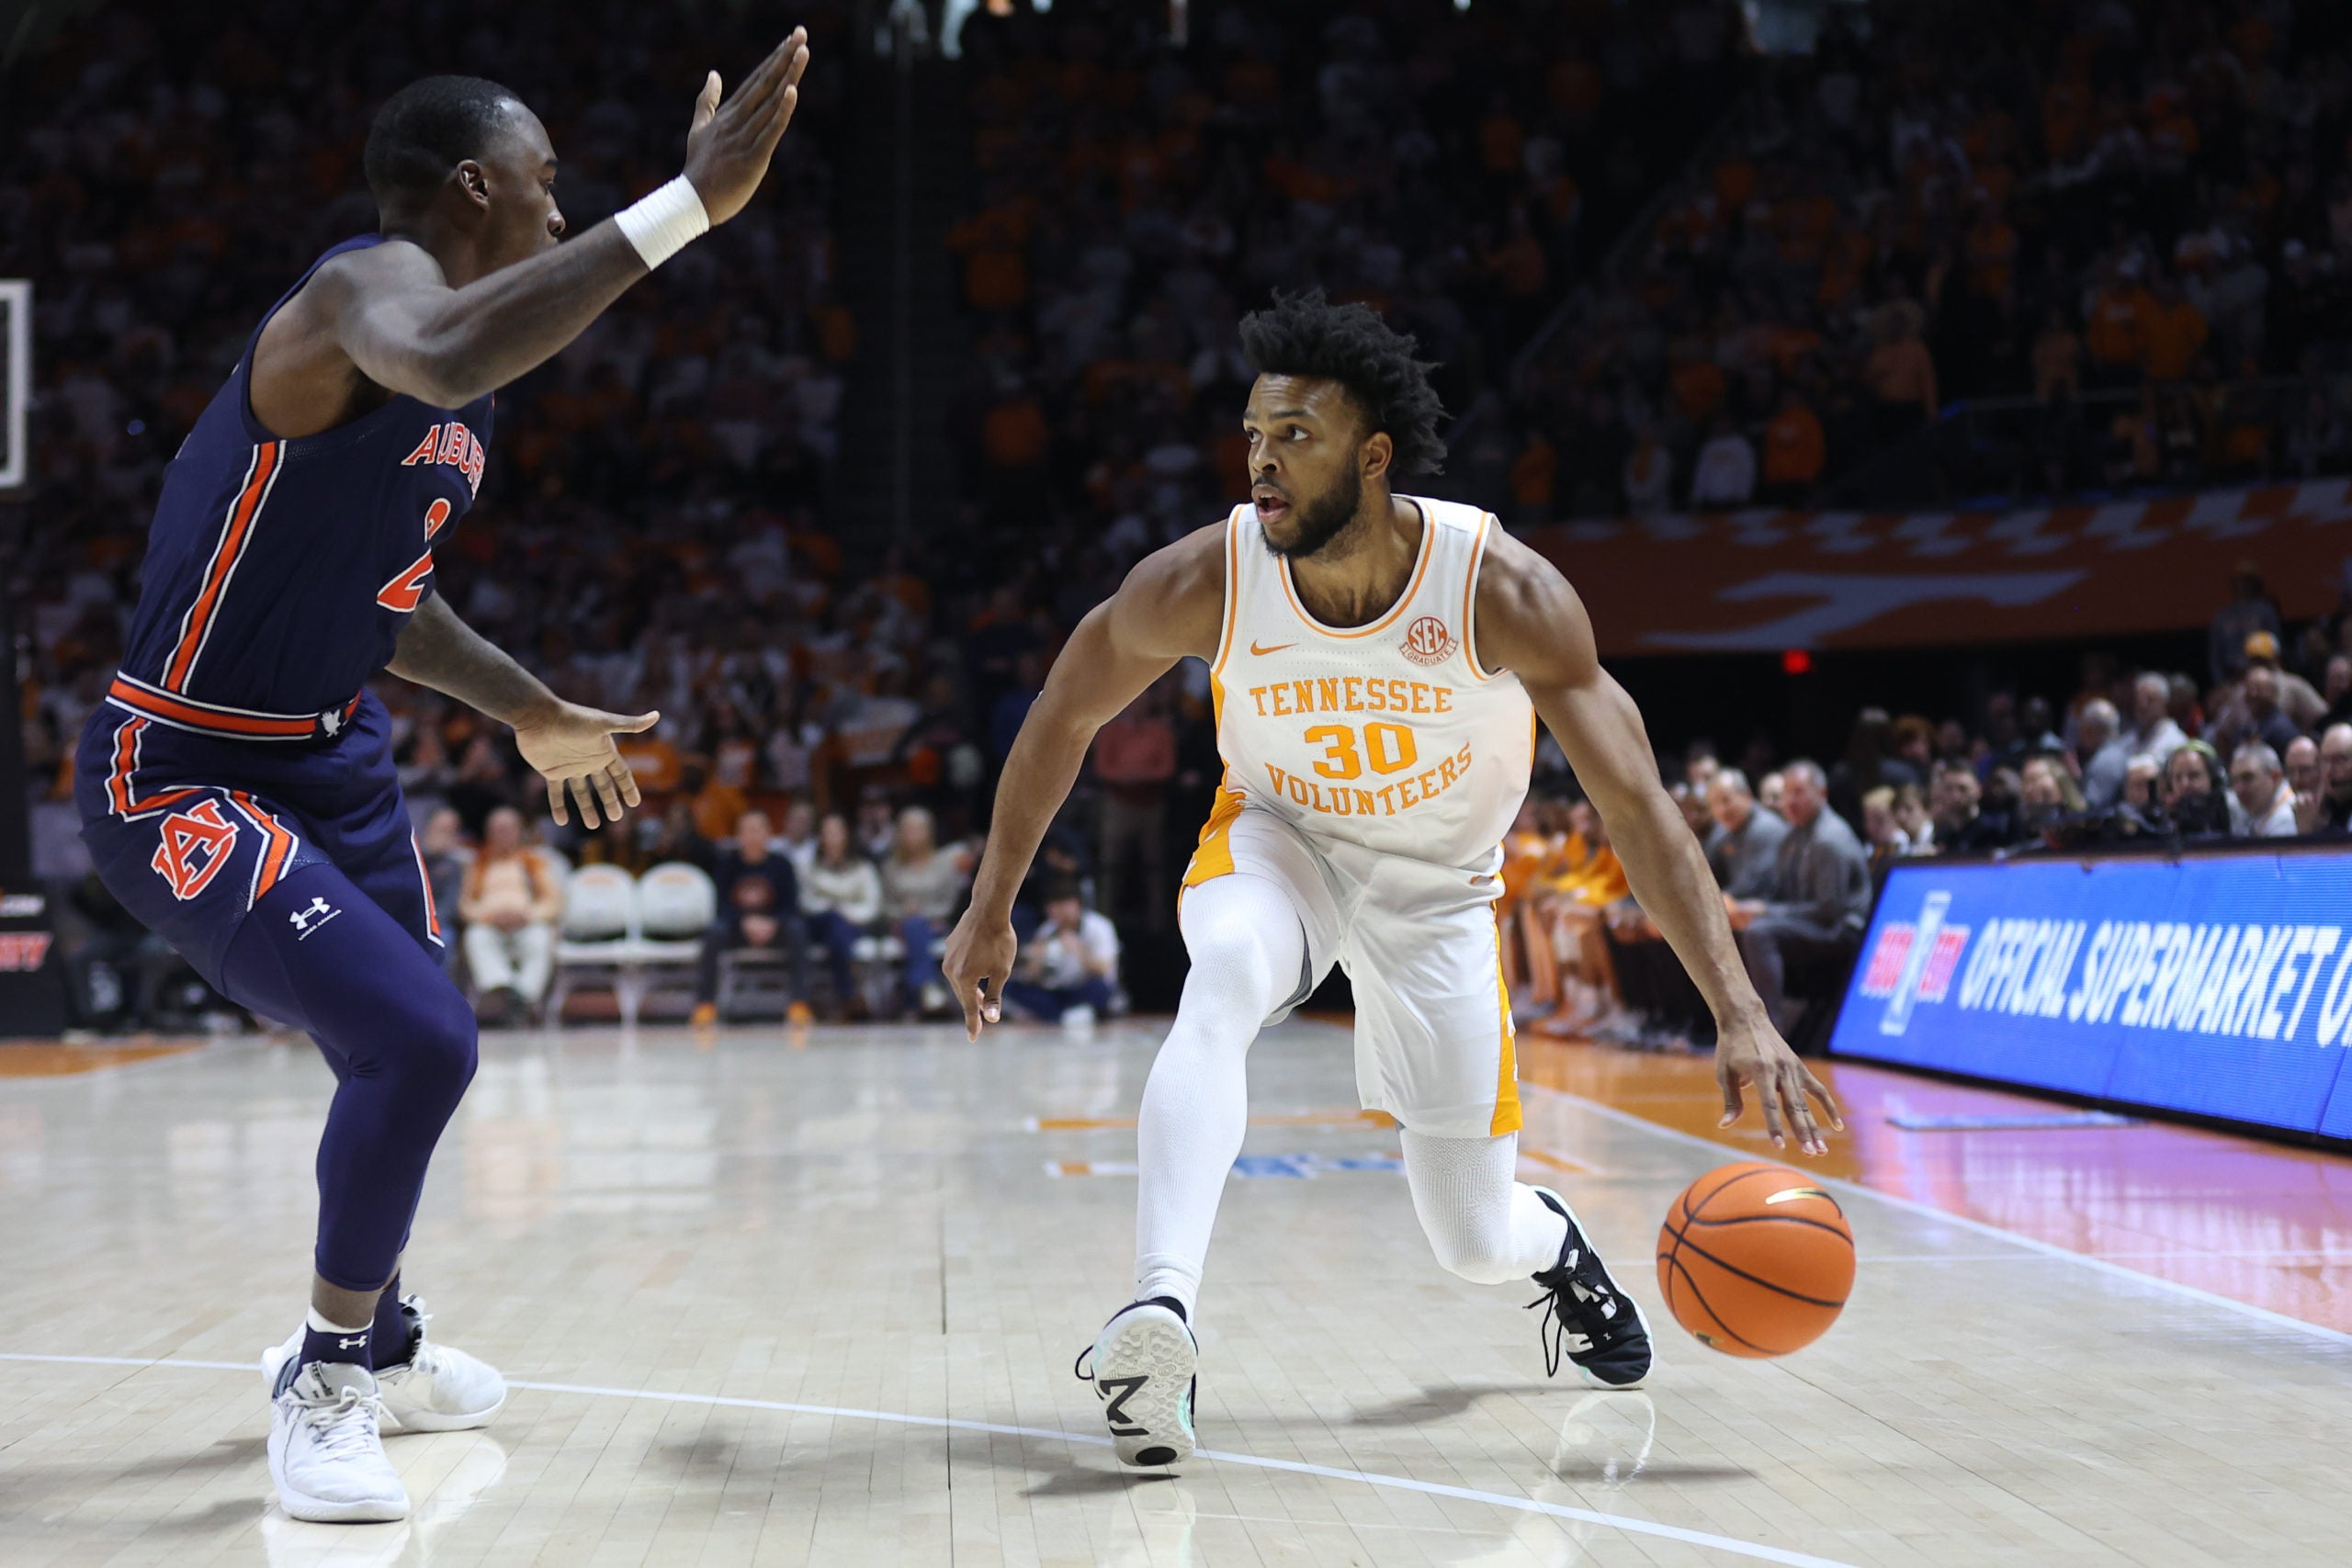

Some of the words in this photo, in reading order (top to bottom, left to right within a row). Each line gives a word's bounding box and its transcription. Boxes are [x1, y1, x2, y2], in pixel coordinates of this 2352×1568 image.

[401, 422, 485, 502] AUBUR
[1407, 648, 1452, 665] GRADUATE
[1408, 617, 1448, 654] SEC
[1250, 677, 1453, 716] TENNESSEE
[1264, 741, 1472, 816] VOLUNTEERS
[1304, 721, 1418, 780] 30
[1959, 917, 2086, 1019] OFFICIAL
[2068, 919, 2342, 1041] SUPERMARKET
[2316, 932, 2352, 1048] O
